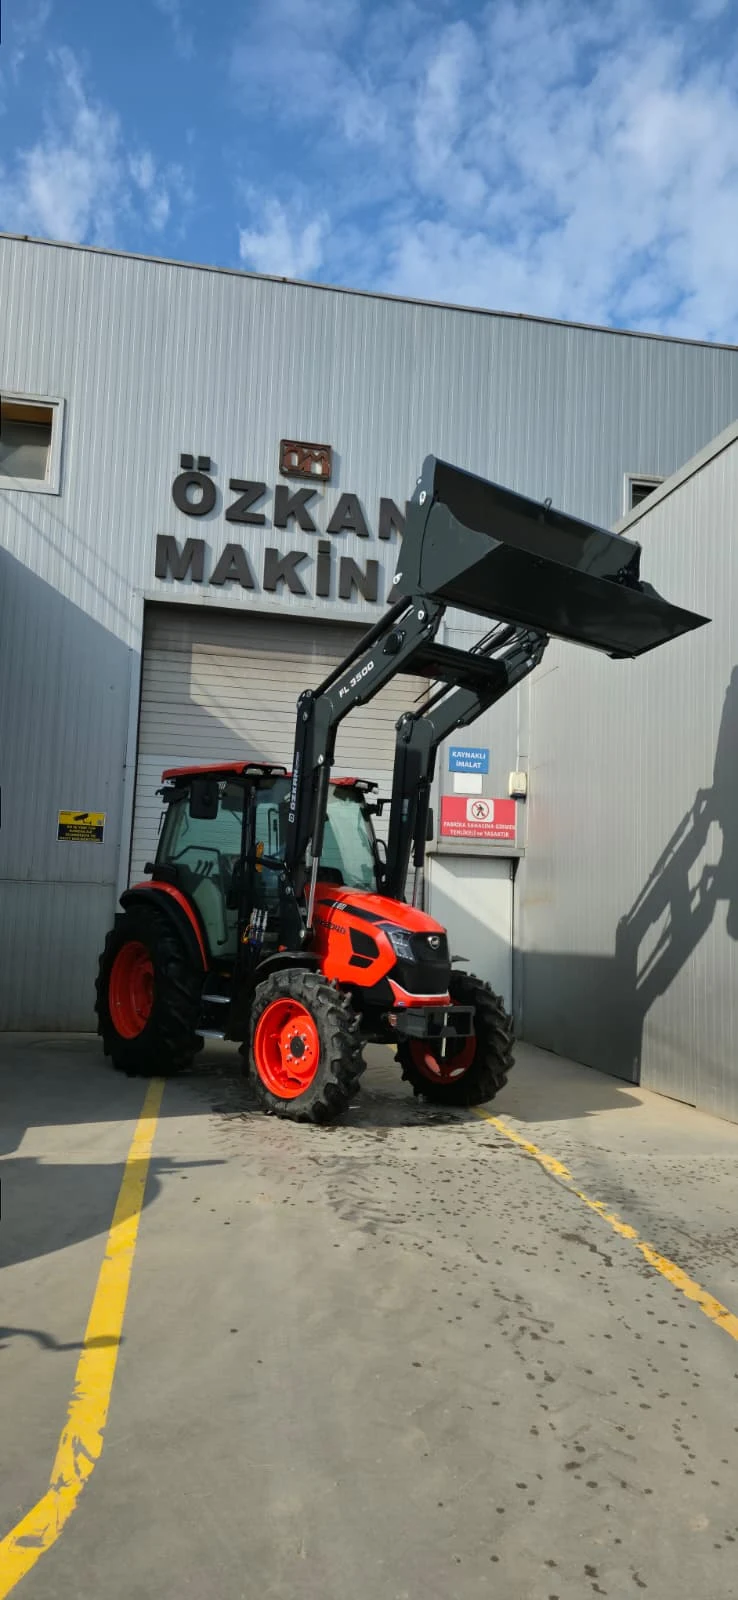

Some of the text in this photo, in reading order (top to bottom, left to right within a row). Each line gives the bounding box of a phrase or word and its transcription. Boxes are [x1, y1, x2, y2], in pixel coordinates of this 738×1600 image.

[172, 453, 406, 540] ÖZKAN
[154, 534, 403, 604] MAKİN
[339, 660, 375, 698] FL 3500
